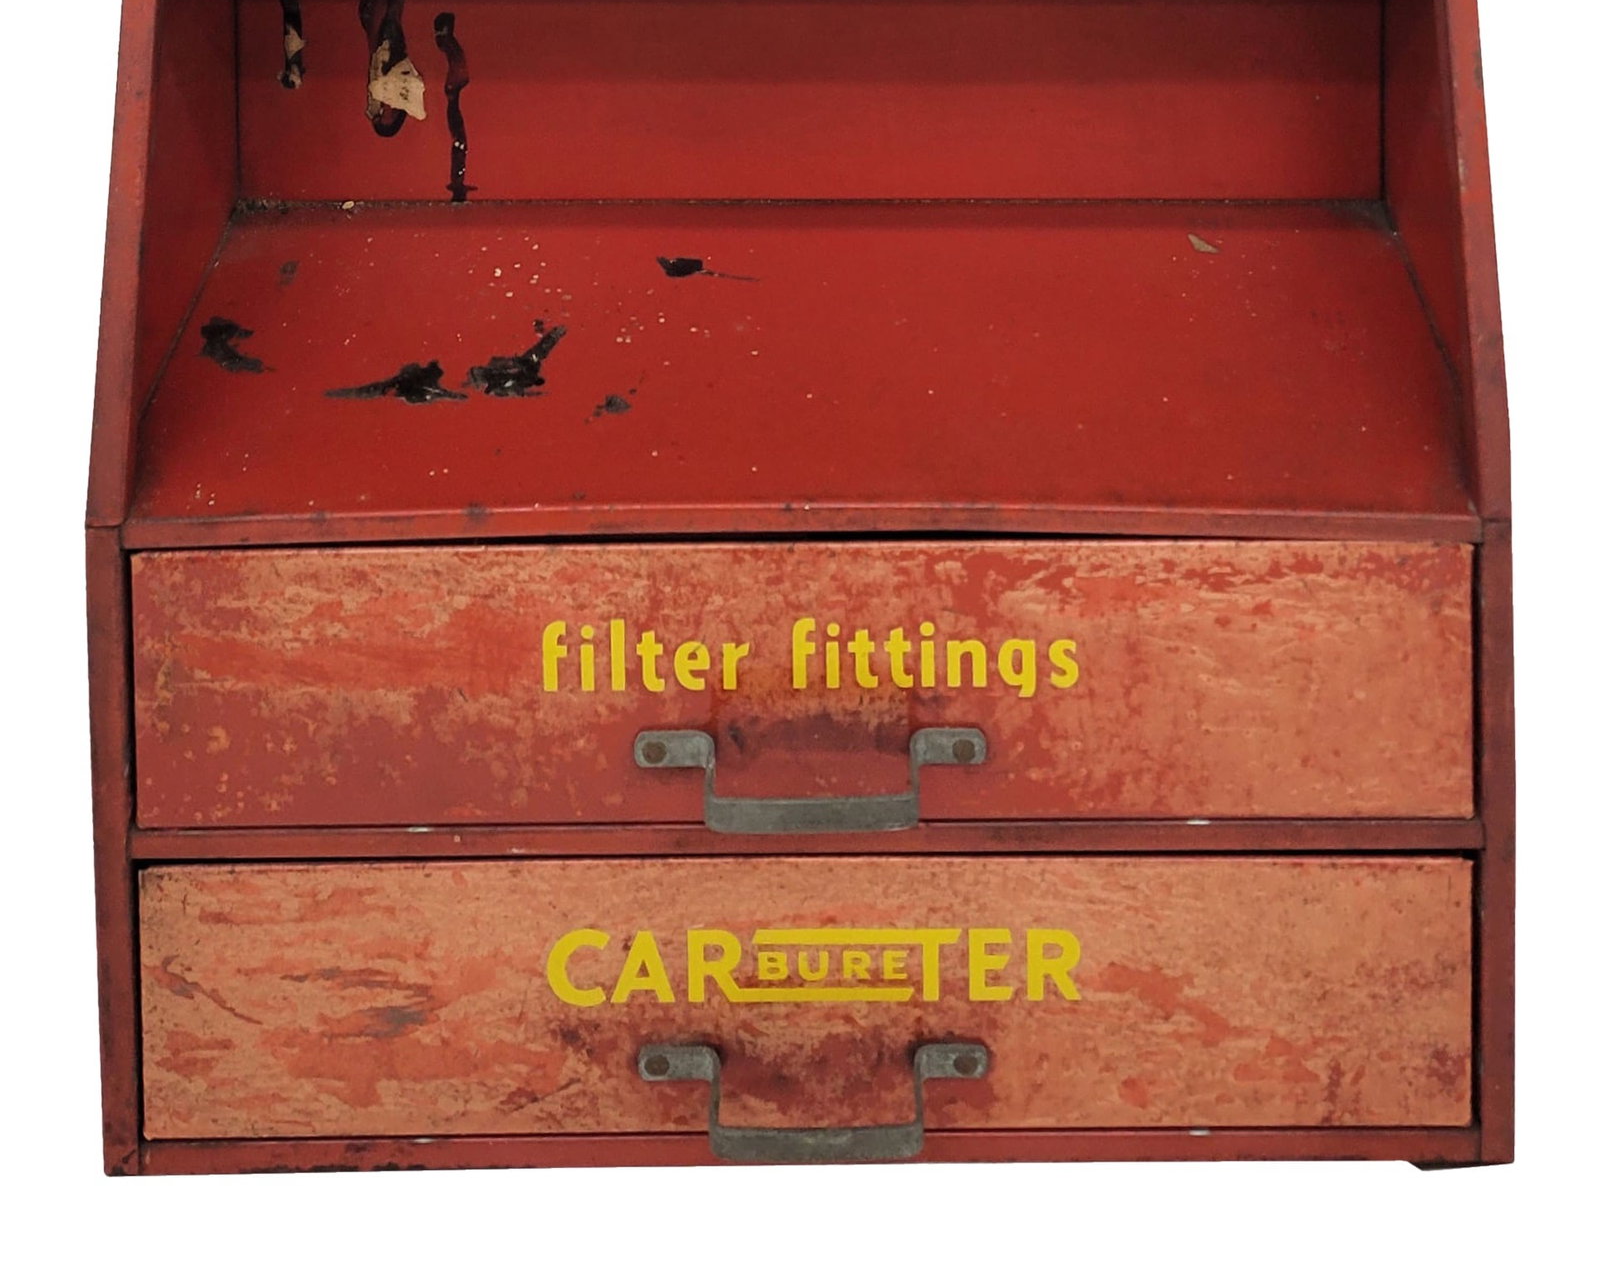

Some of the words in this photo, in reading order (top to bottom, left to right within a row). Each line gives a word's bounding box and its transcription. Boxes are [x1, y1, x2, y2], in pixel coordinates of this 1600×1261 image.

[541, 618, 751, 693] filter
[791, 617, 1081, 698] fittings
[545, 927, 1083, 1008] CARBURETER
